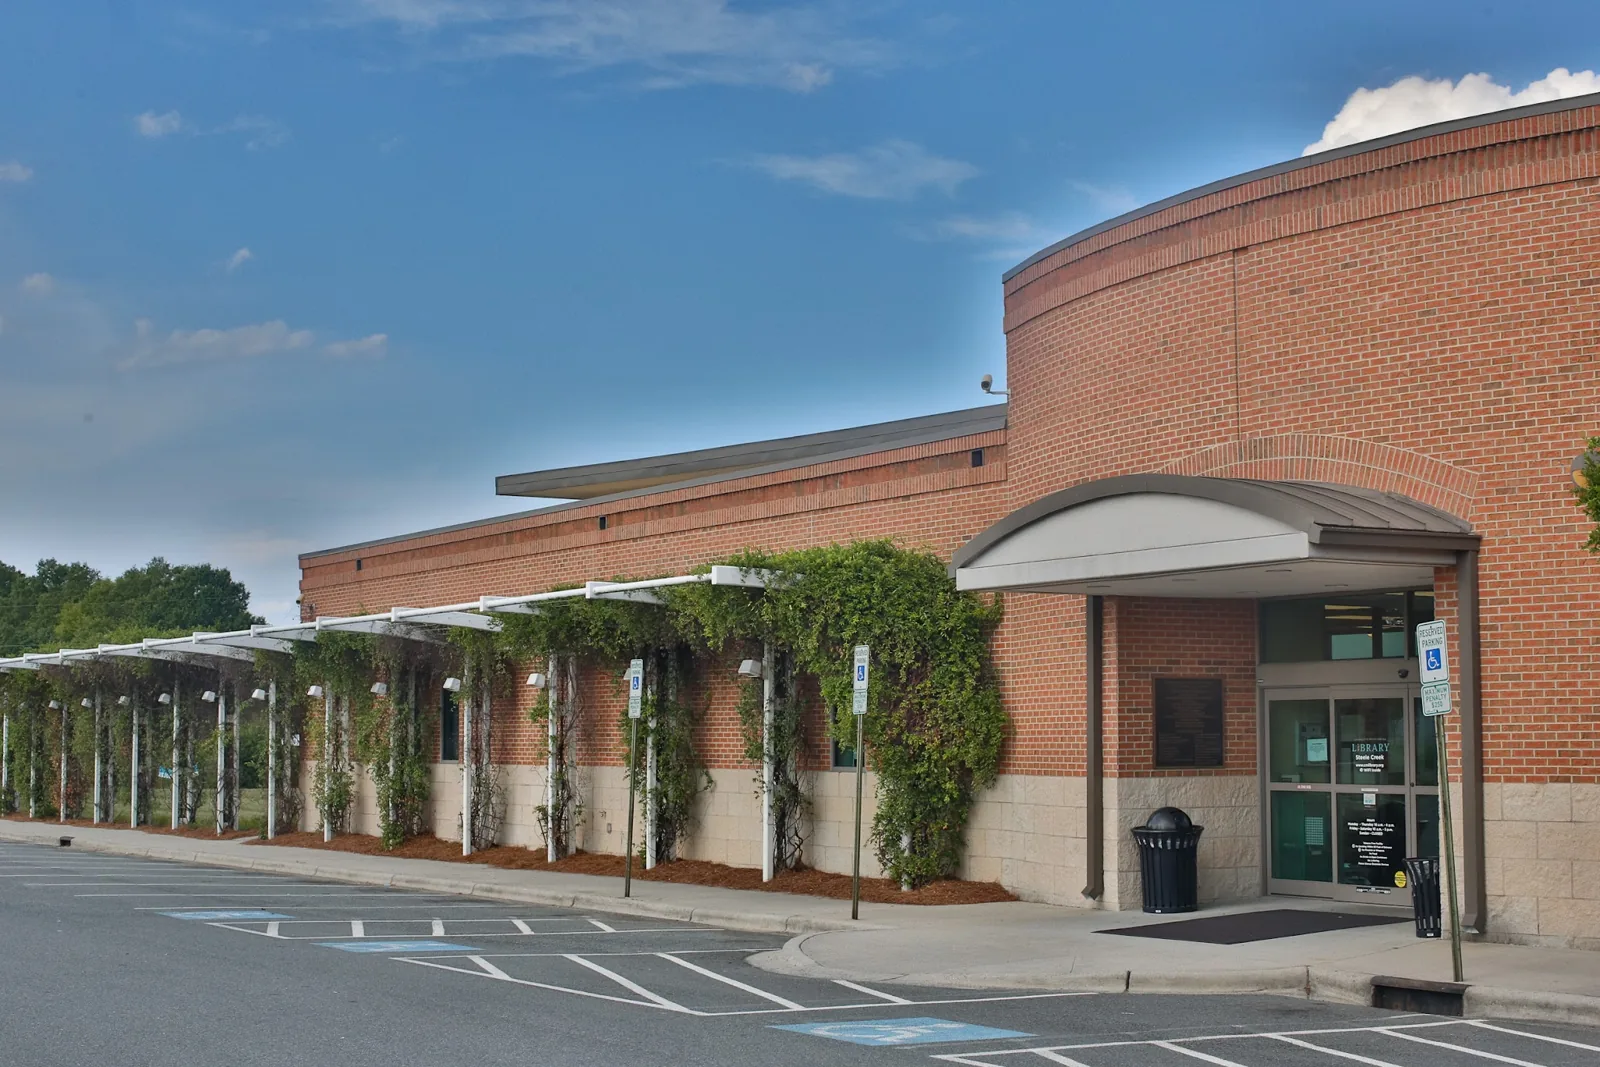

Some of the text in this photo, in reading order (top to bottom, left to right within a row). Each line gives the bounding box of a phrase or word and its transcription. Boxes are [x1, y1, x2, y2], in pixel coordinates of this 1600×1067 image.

[1420, 626, 1443, 637] RESERVED
[1422, 637, 1443, 648] PARKING
[1425, 687, 1448, 695] MAXIMUM
[1426, 693, 1447, 702] PENALTY
